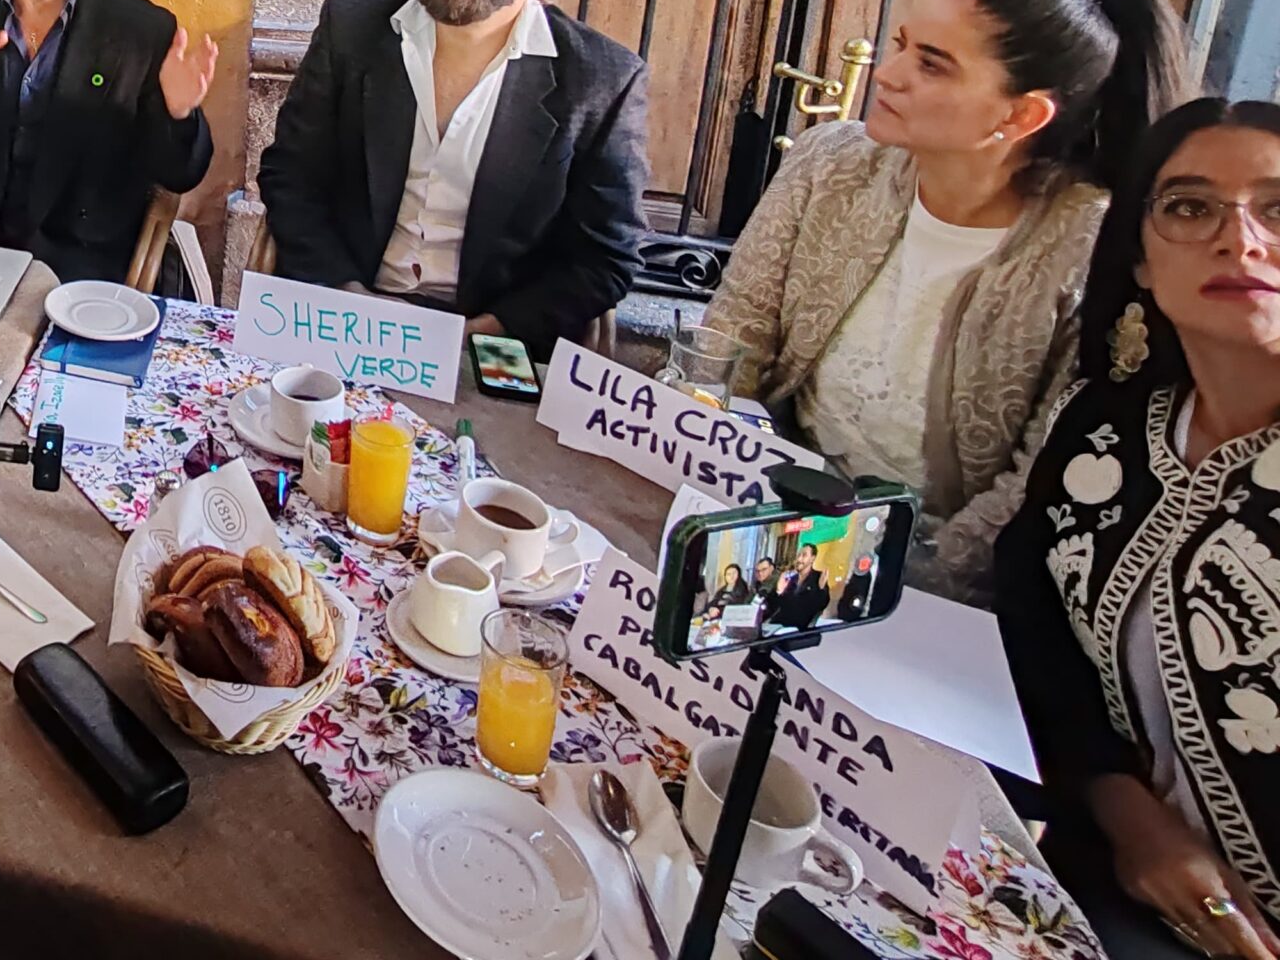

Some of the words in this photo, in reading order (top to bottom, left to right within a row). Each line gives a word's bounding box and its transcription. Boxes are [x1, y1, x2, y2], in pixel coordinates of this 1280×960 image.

[253, 293, 422, 354] SHERIFF
[334, 350, 440, 389] VERDE
[569, 354, 657, 420] LILA
[586, 408, 764, 505] ACTIVISTA
[213, 498, 237, 533] 1810
[584, 633, 742, 738] CABALGAT
